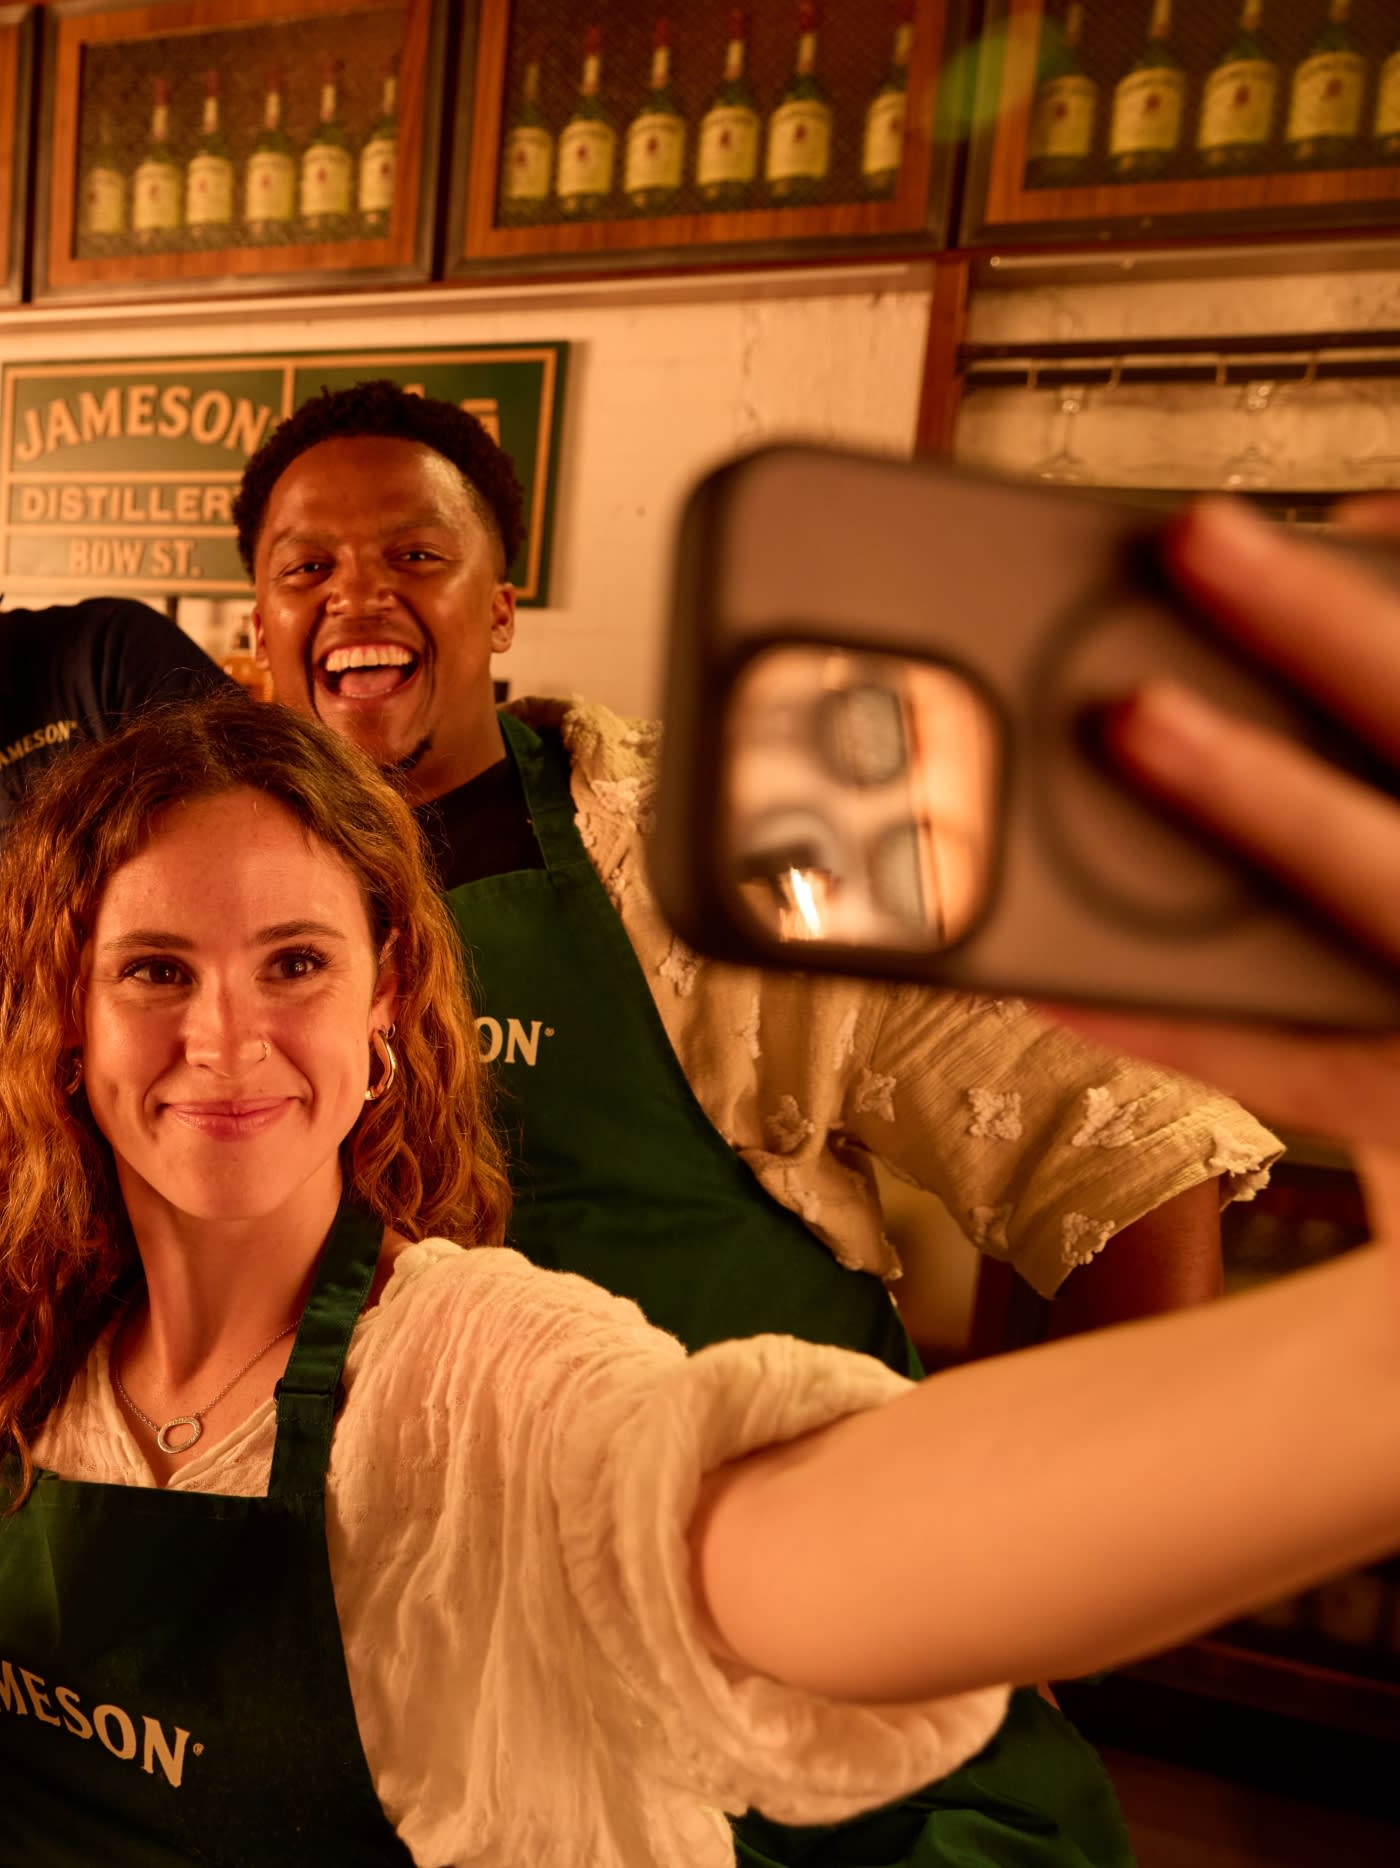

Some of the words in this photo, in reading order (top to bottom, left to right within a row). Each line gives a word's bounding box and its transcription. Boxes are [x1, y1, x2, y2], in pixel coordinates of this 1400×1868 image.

[15, 384, 271, 461] JAMESON
[21, 486, 241, 521] DISTILLER
[69, 540, 142, 577] BOW
[150, 539, 201, 578] ST.
